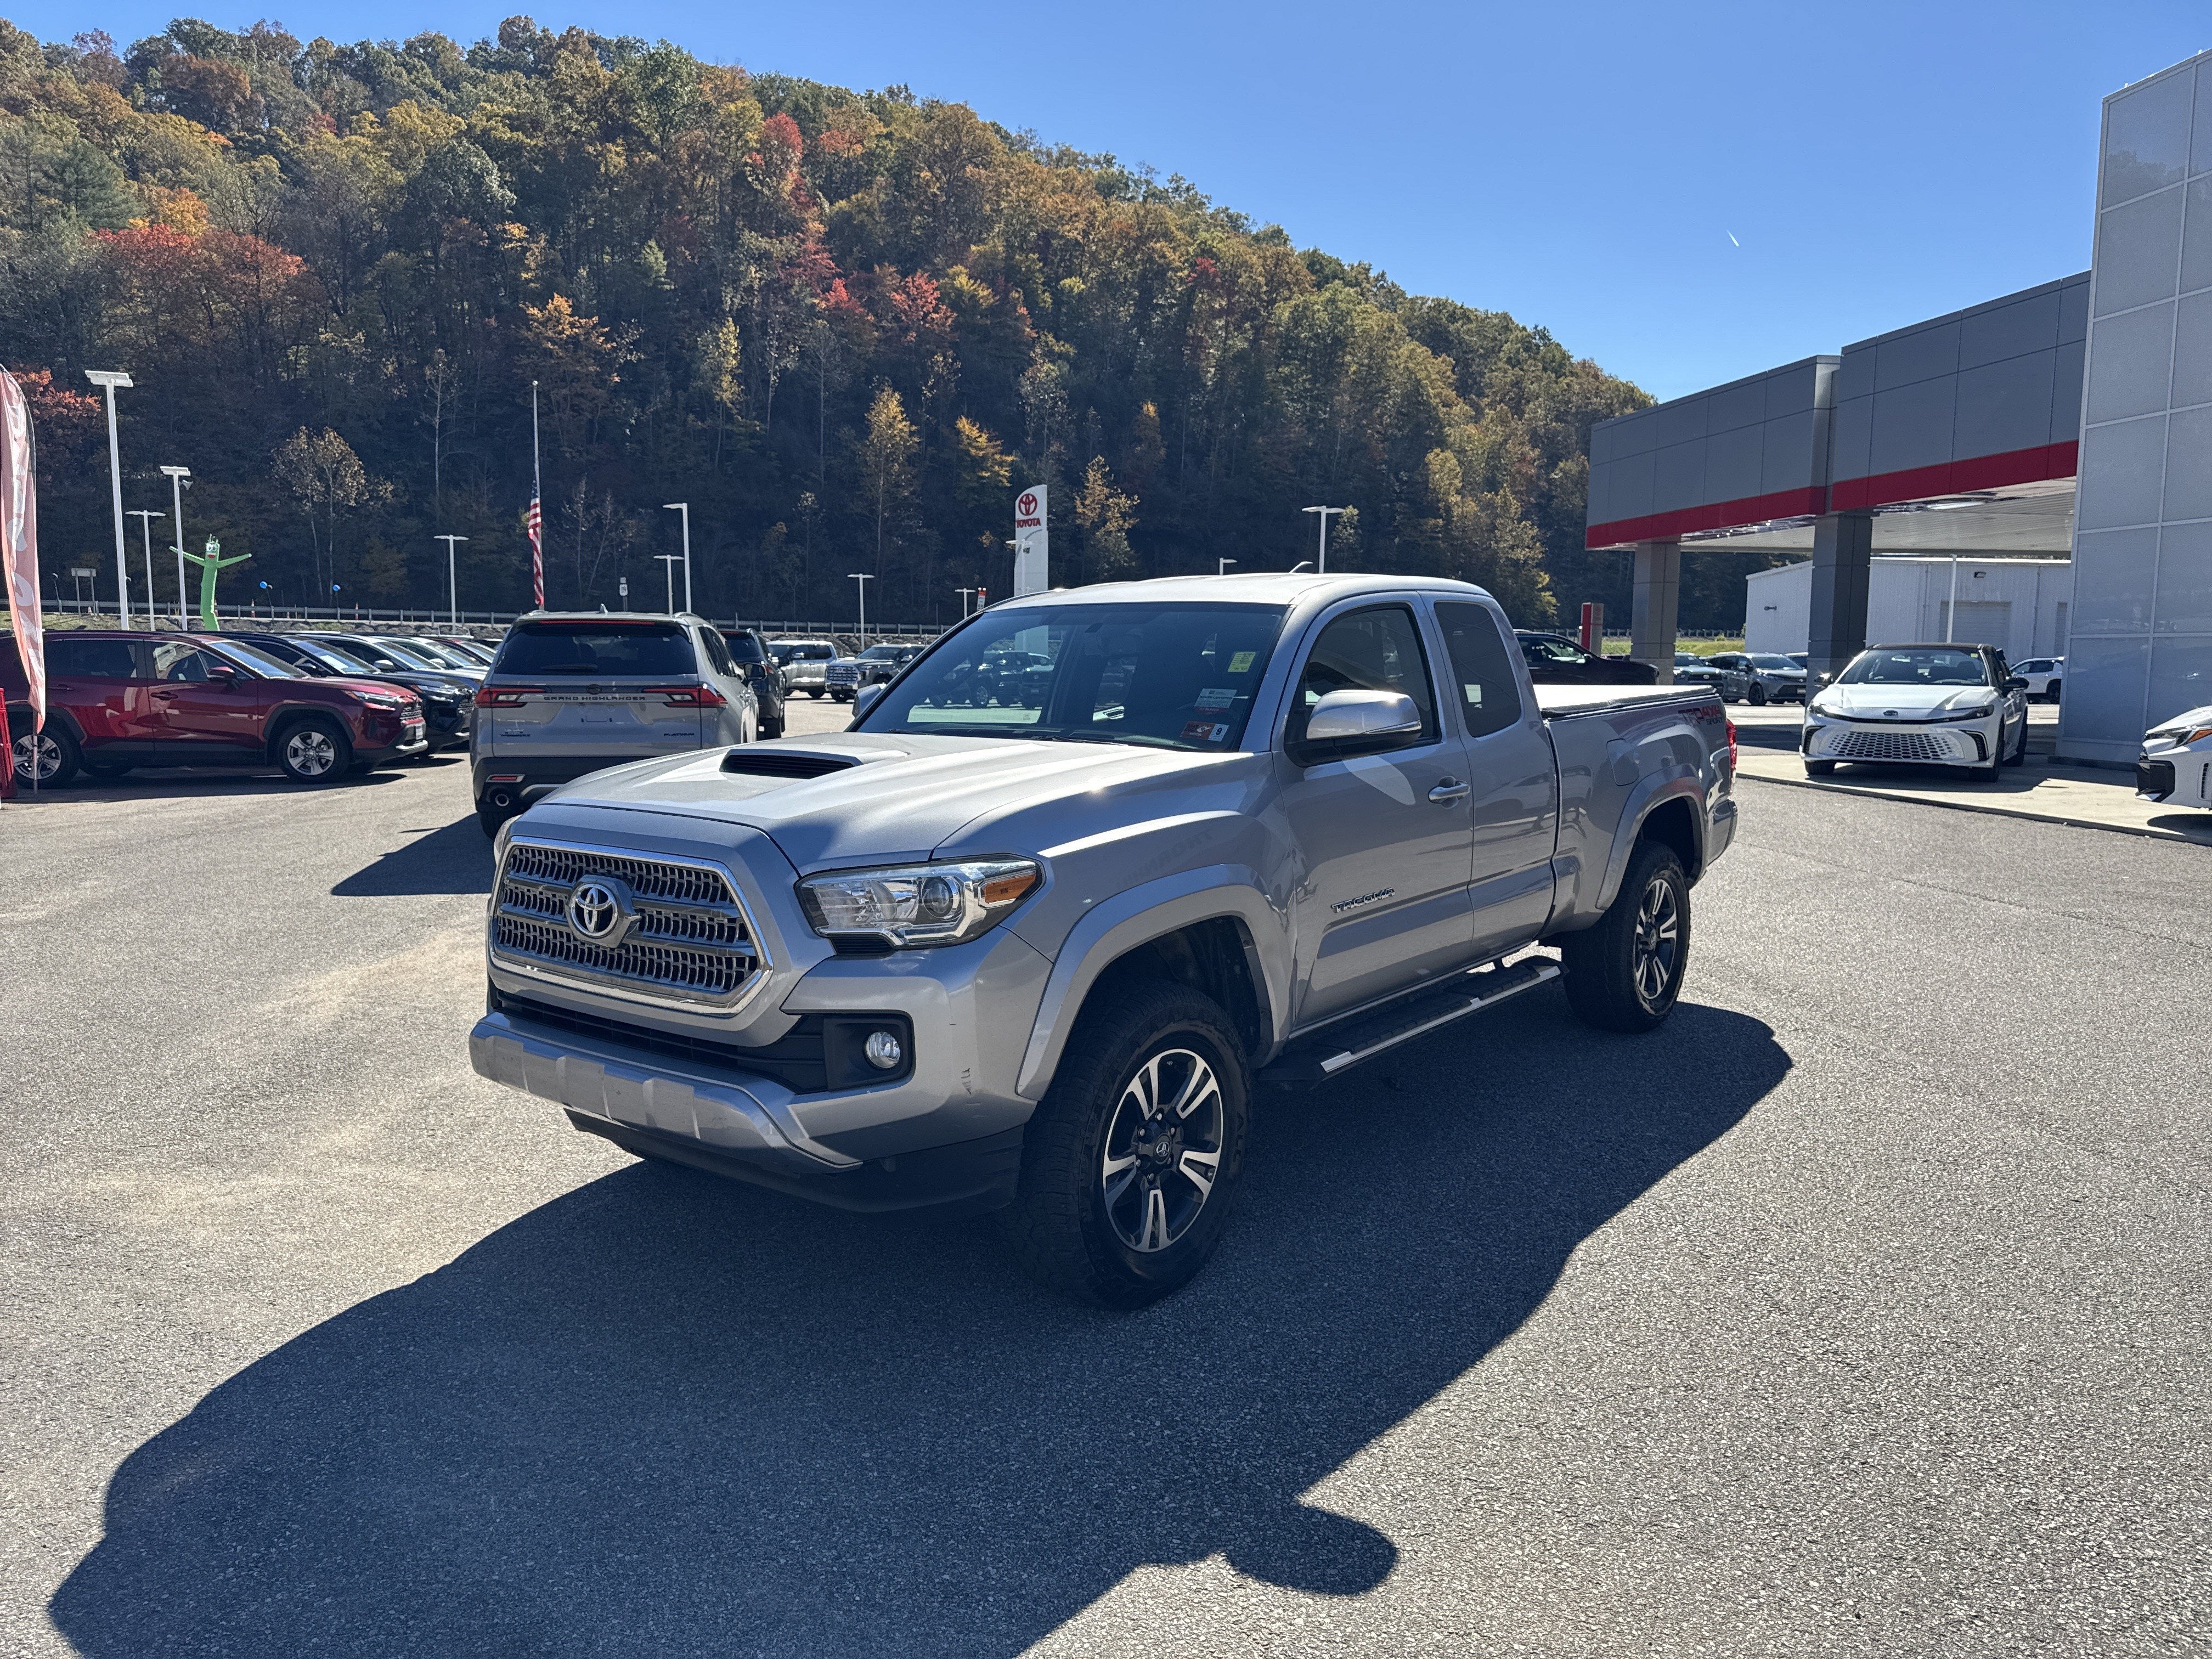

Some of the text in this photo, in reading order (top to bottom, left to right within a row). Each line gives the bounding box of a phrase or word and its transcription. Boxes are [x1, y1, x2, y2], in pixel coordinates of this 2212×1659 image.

[1015, 518, 1041, 528] TOYOTA
[1677, 708, 1704, 727] TRD
[1706, 716, 1723, 725] SPORT
[1215, 727, 1223, 736] 9
[1330, 887, 1396, 913] TACOMA
